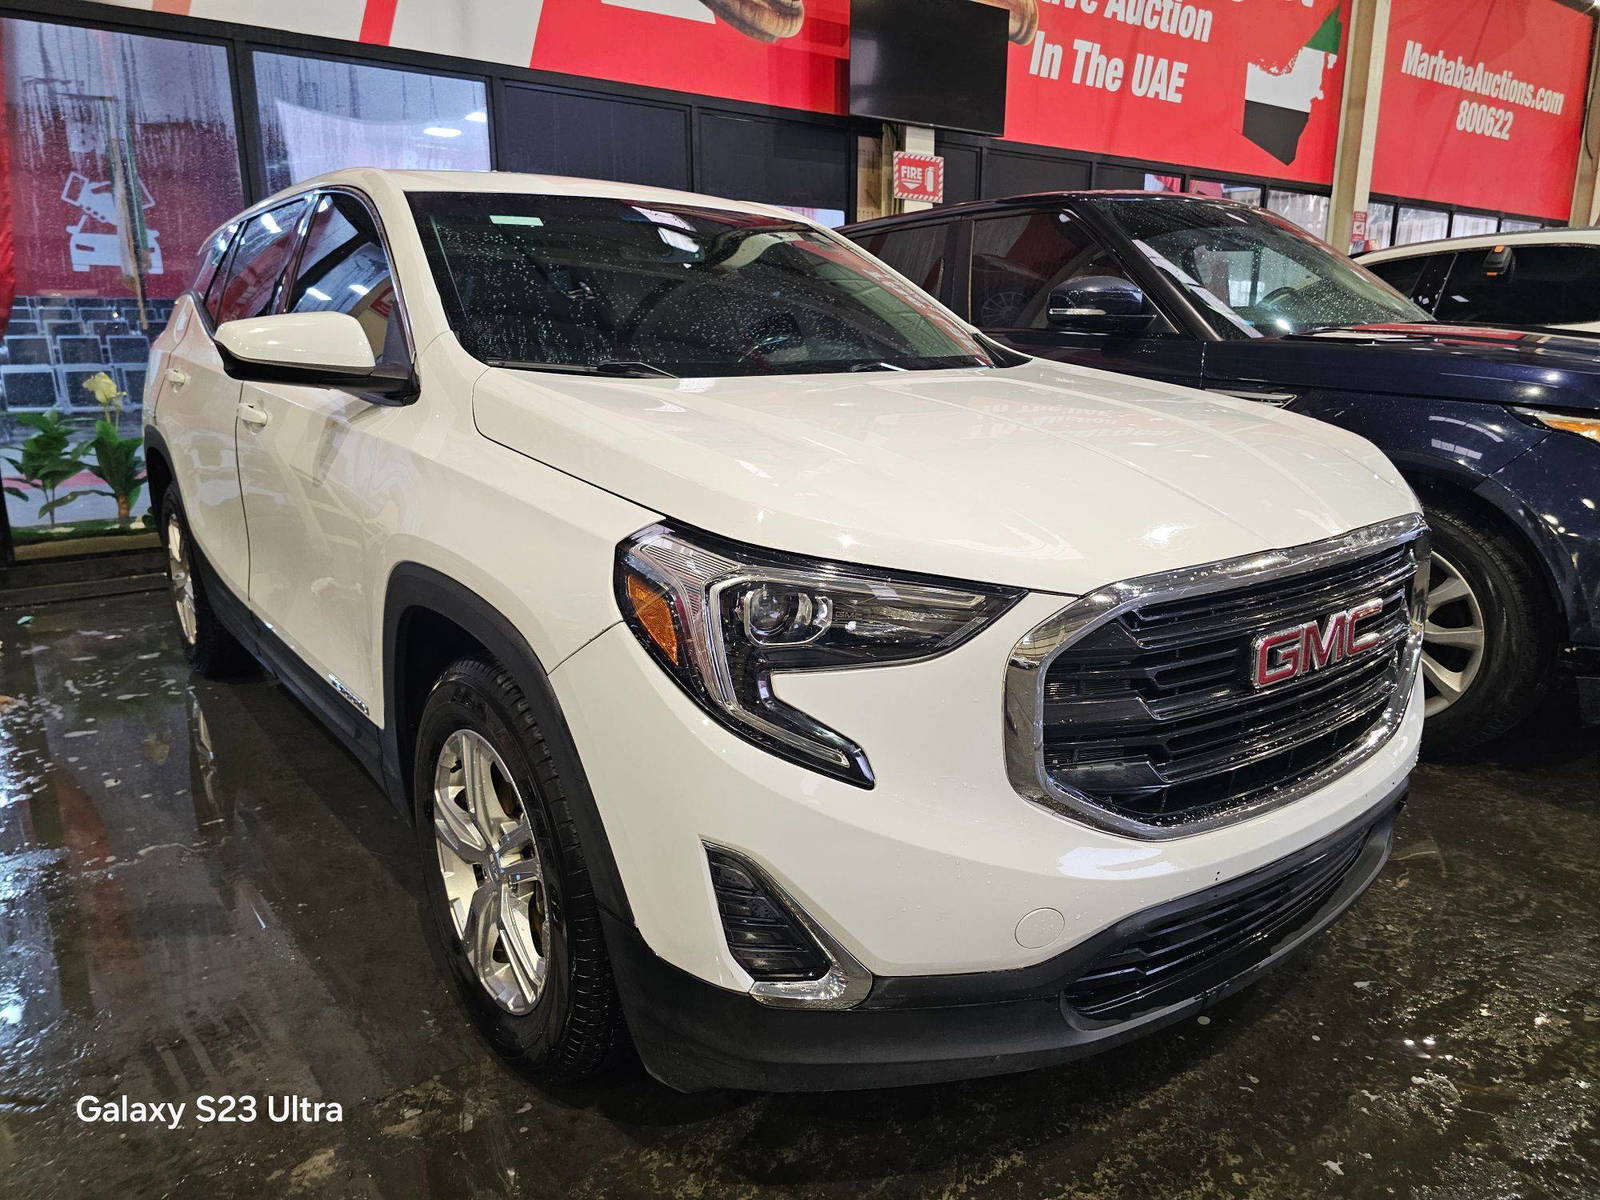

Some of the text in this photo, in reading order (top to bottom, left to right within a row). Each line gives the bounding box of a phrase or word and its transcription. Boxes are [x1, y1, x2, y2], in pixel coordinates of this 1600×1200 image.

[1028, 30, 1189, 103] In The UAE
[1401, 40, 1565, 115] MarhabaAuctions.com
[1456, 100, 1514, 140] 800622
[901, 165, 923, 180] FIRE
[1251, 597, 1384, 689] GMC
